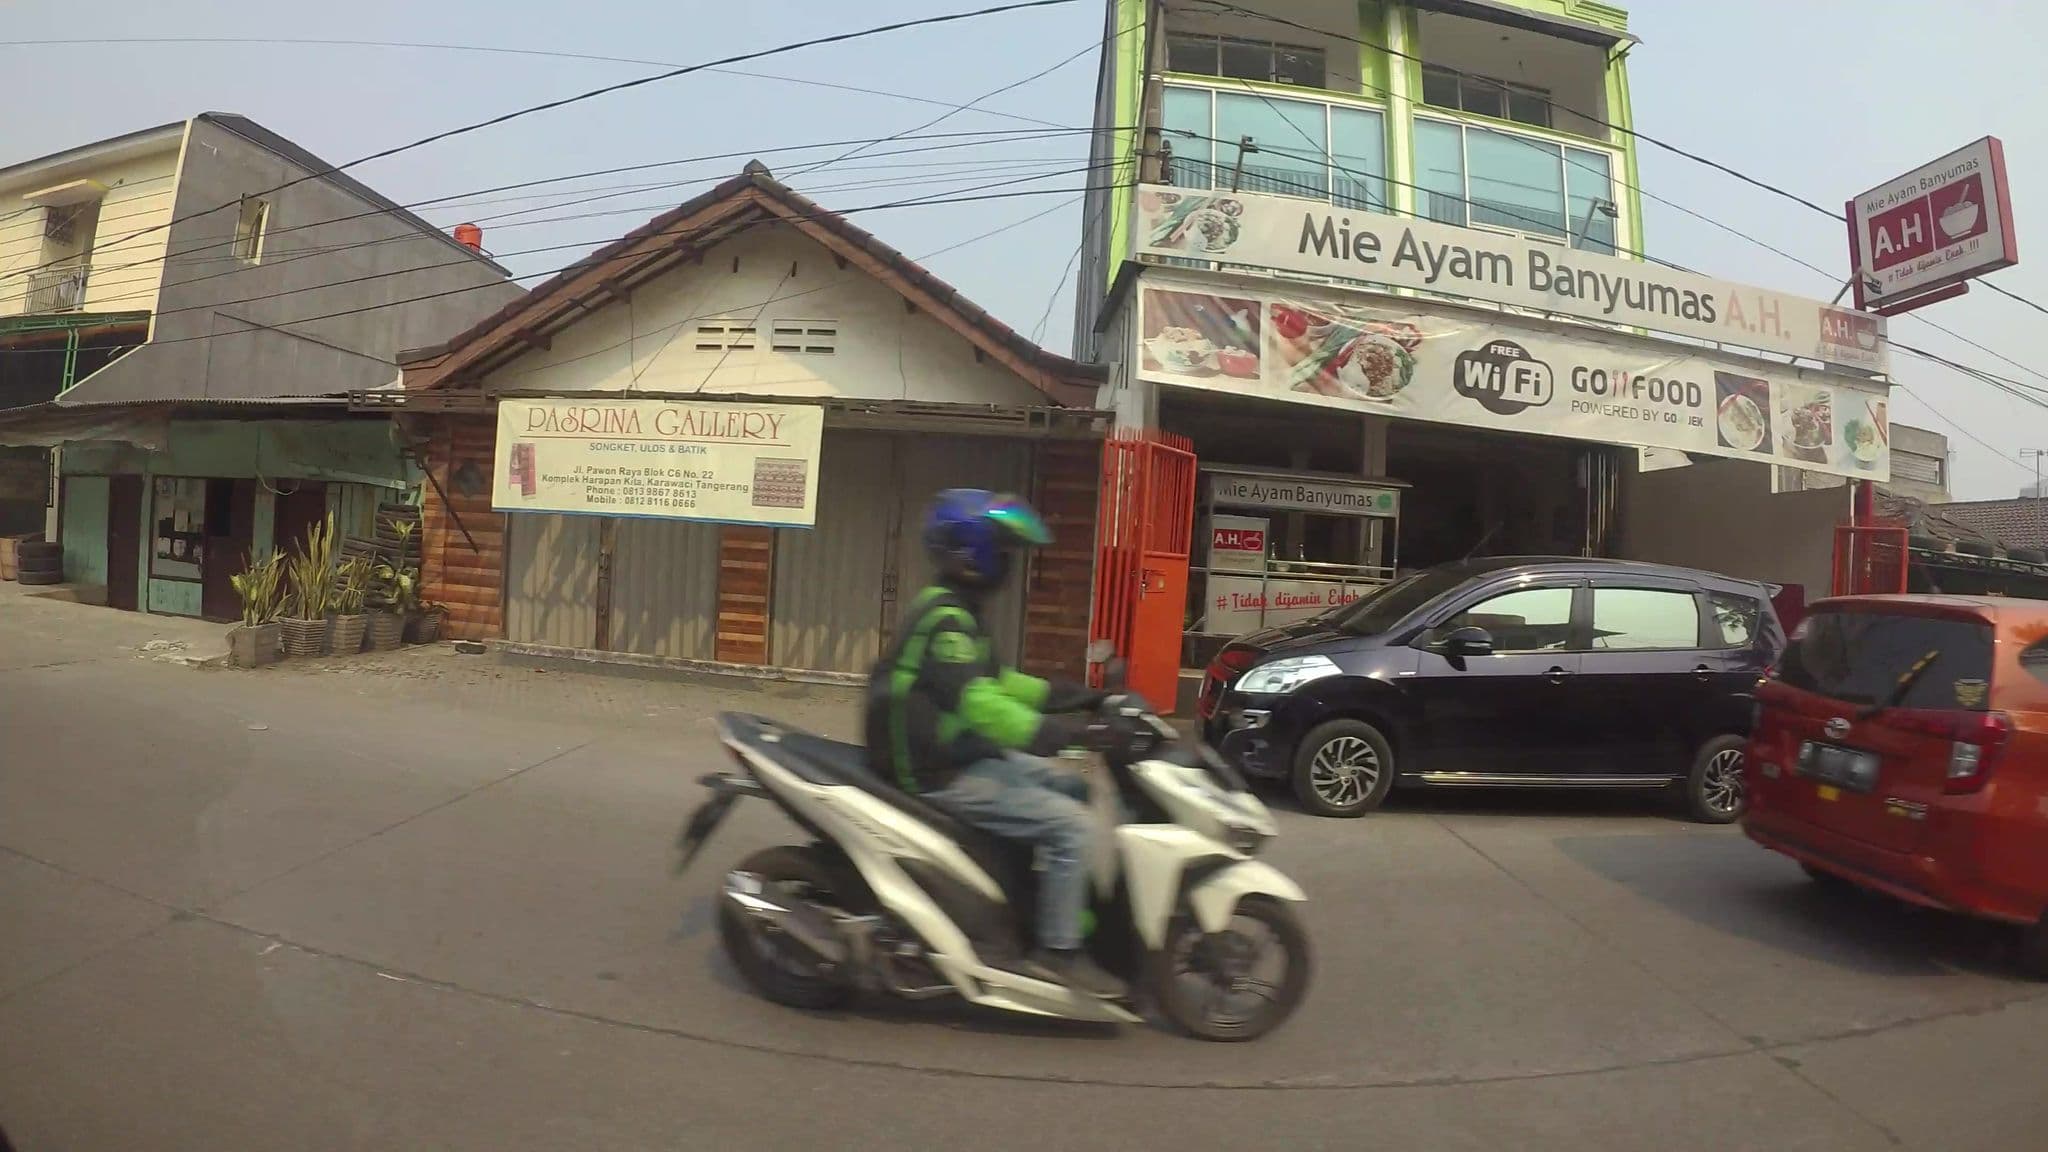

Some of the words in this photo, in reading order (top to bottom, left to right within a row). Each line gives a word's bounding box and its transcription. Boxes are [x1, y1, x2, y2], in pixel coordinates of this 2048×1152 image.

[1866, 199, 1885, 213] Mie
[1887, 184, 1917, 205] Ayam
[1919, 158, 1979, 190] Banyumas
[1874, 213, 1923, 259] A.H
[1298, 212, 1381, 264] Mie
[1391, 227, 1513, 286] Ayam
[1528, 249, 1717, 324] Banyumas
[1723, 288, 1792, 340] A.H.
[1490, 344, 1520, 358] FREE
[1631, 375, 1702, 408] FOOD
[1571, 400, 1638, 419] POWERED
[1643, 408, 1659, 421] BY
[526, 407, 642, 434] PASRINA
[655, 408, 786, 439] GALLERY
[640, 444, 666, 453] ULOS
[668, 445, 675, 453] &
[678, 445, 707, 455] BATIK
[586, 466, 616, 475] Pawon
[619, 467, 641, 478] Raya
[644, 468, 664, 477] Blok
[667, 469, 680, 478] C6
[683, 470, 699, 479] No.
[702, 471, 714, 480] 22
[542, 474, 579, 484] Komplek
[582, 475, 620, 487] Harapan
[647, 478, 693, 489] Karawaci
[696, 480, 749, 493] Tangerang
[586, 485, 615, 495] Phone
[623, 487, 644, 496] 0813
[586, 494, 617, 505] Mobile
[624, 496, 645, 505] 0812
[1251, 483, 1293, 503] Ayam
[1296, 486, 1373, 507] Banyumas
[1214, 532, 1241, 545] A.H.
[1216, 595, 1228, 609] #
